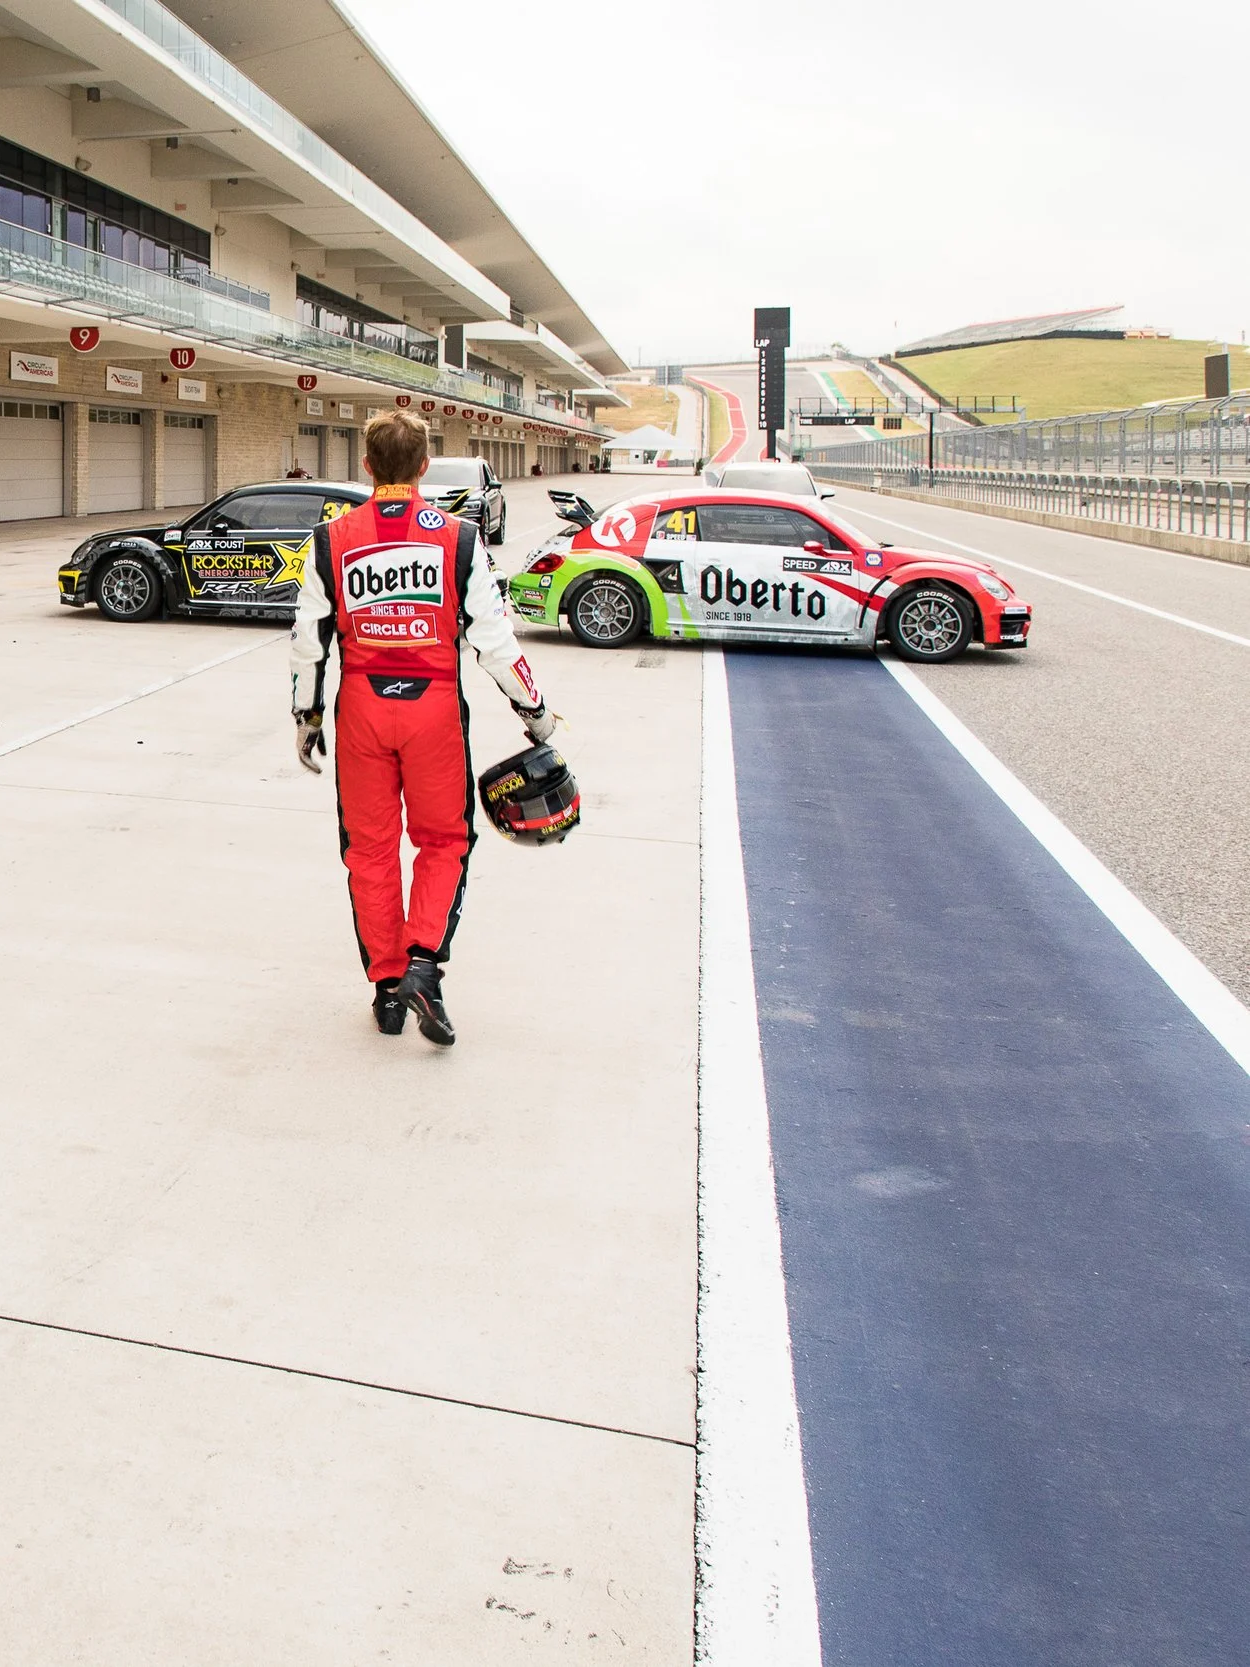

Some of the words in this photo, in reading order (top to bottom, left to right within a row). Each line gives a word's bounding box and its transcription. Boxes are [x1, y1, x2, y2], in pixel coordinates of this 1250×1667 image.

[79, 328, 90, 345] 9
[755, 339, 770, 347] LAP
[176, 350, 189, 365] 10
[302, 377, 312, 388] 12
[399, 396, 408, 406] 13
[425, 402, 432, 410] 14
[446, 406, 453, 414] 15
[666, 510, 696, 533] 41
[214, 540, 243, 549] FOUST
[113, 560, 142, 569] COOPER
[192, 554, 273, 569] ROCKSTAR
[783, 559, 817, 570] SPEED
[199, 569, 235, 577] ENERGY
[238, 569, 267, 577] DRINK
[348, 560, 437, 600] Oberto
[593, 579, 626, 591] COOPER
[200, 581, 257, 595] RZR
[700, 564, 826, 621] Oberto
[917, 591, 955, 603] COOPER
[371, 605, 395, 615] SINCE
[397, 605, 415, 615] 1918
[706, 611, 730, 621] SINCE
[733, 612, 752, 622] 1918
[360, 622, 407, 636] CIRCLE
